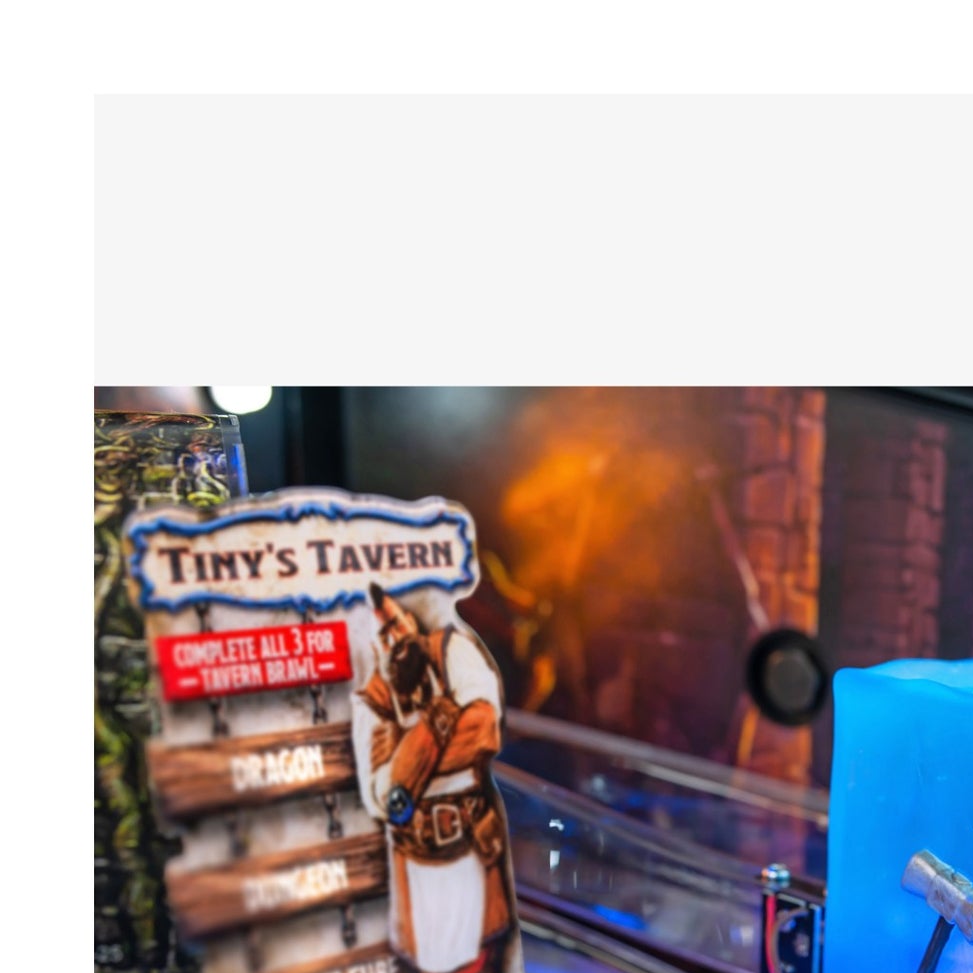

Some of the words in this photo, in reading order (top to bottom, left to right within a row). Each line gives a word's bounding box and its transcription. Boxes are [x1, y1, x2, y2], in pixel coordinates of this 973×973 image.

[158, 543, 299, 584] TINY'S
[306, 540, 455, 575] TAVERN
[172, 635, 257, 668] COMPLETE
[259, 633, 289, 658] ALL
[290, 627, 303, 655] 3
[306, 629, 335, 653] FOR
[201, 662, 263, 692] TAVERN
[267, 657, 319, 686] BRAWL
[229, 744, 325, 792] DRAGON
